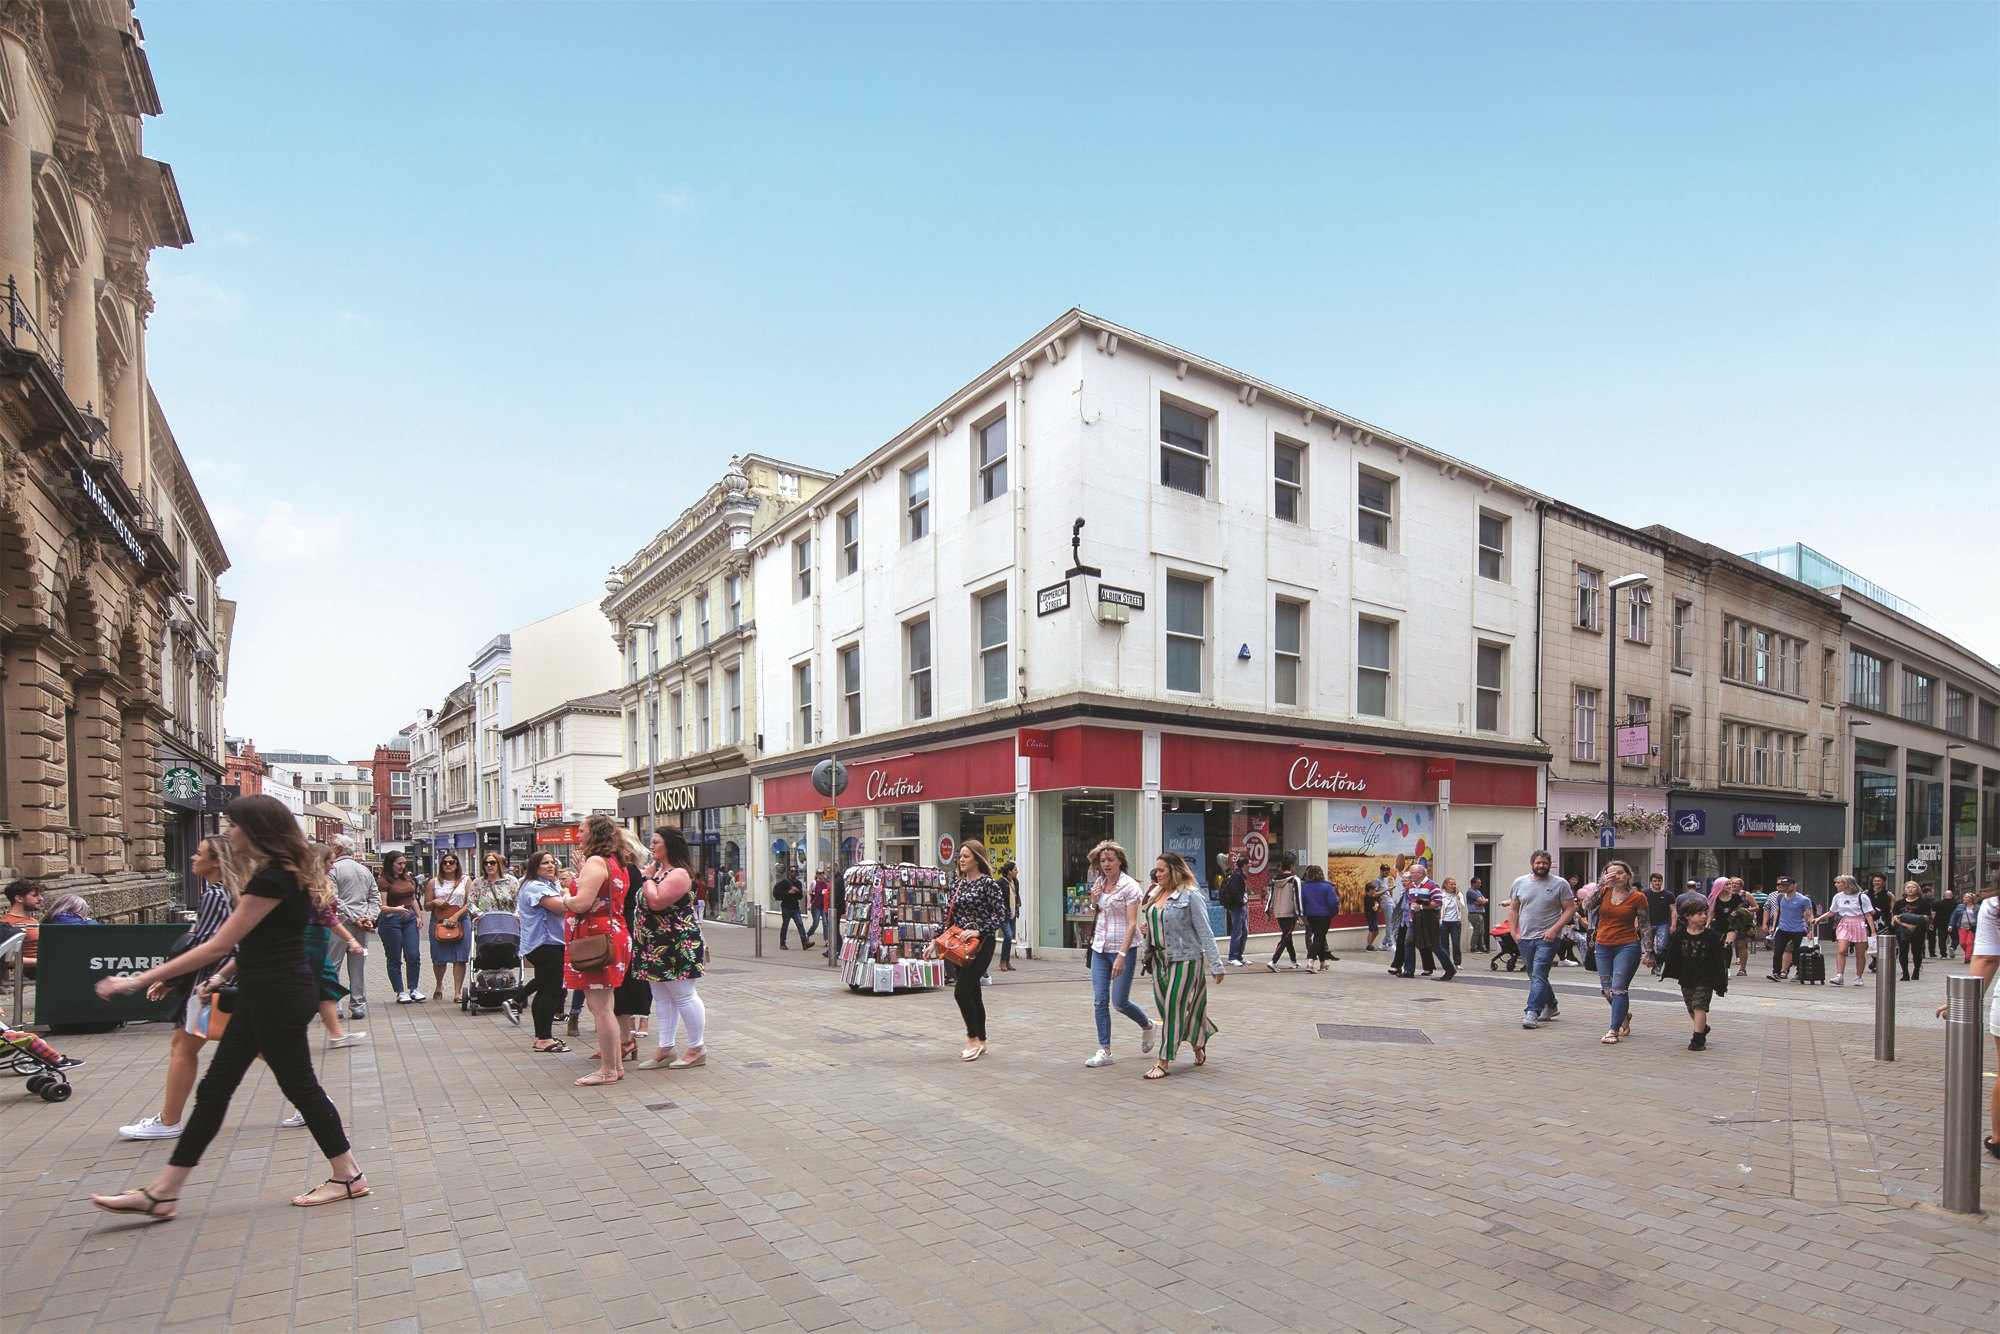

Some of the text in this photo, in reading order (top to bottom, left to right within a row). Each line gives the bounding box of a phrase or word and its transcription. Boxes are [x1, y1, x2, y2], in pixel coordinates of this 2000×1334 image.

[82, 468, 145, 567] STARBUCKS COFFEE
[1040, 586, 1067, 603] COMMERCIAL
[1101, 590, 1143, 606] ALBION STREET
[1045, 598, 1062, 611] STREET
[1288, 756, 1367, 793] Clintons
[866, 770, 923, 801] Clintons
[986, 823, 1013, 836] FUNNY
[1746, 817, 1802, 834] Nationwide Building Society
[989, 836, 1010, 845] CARDS
[1169, 837, 1202, 850] KING DAD
[1332, 821, 1383, 855] Celebrating life
[1246, 844, 1264, 860] 70
